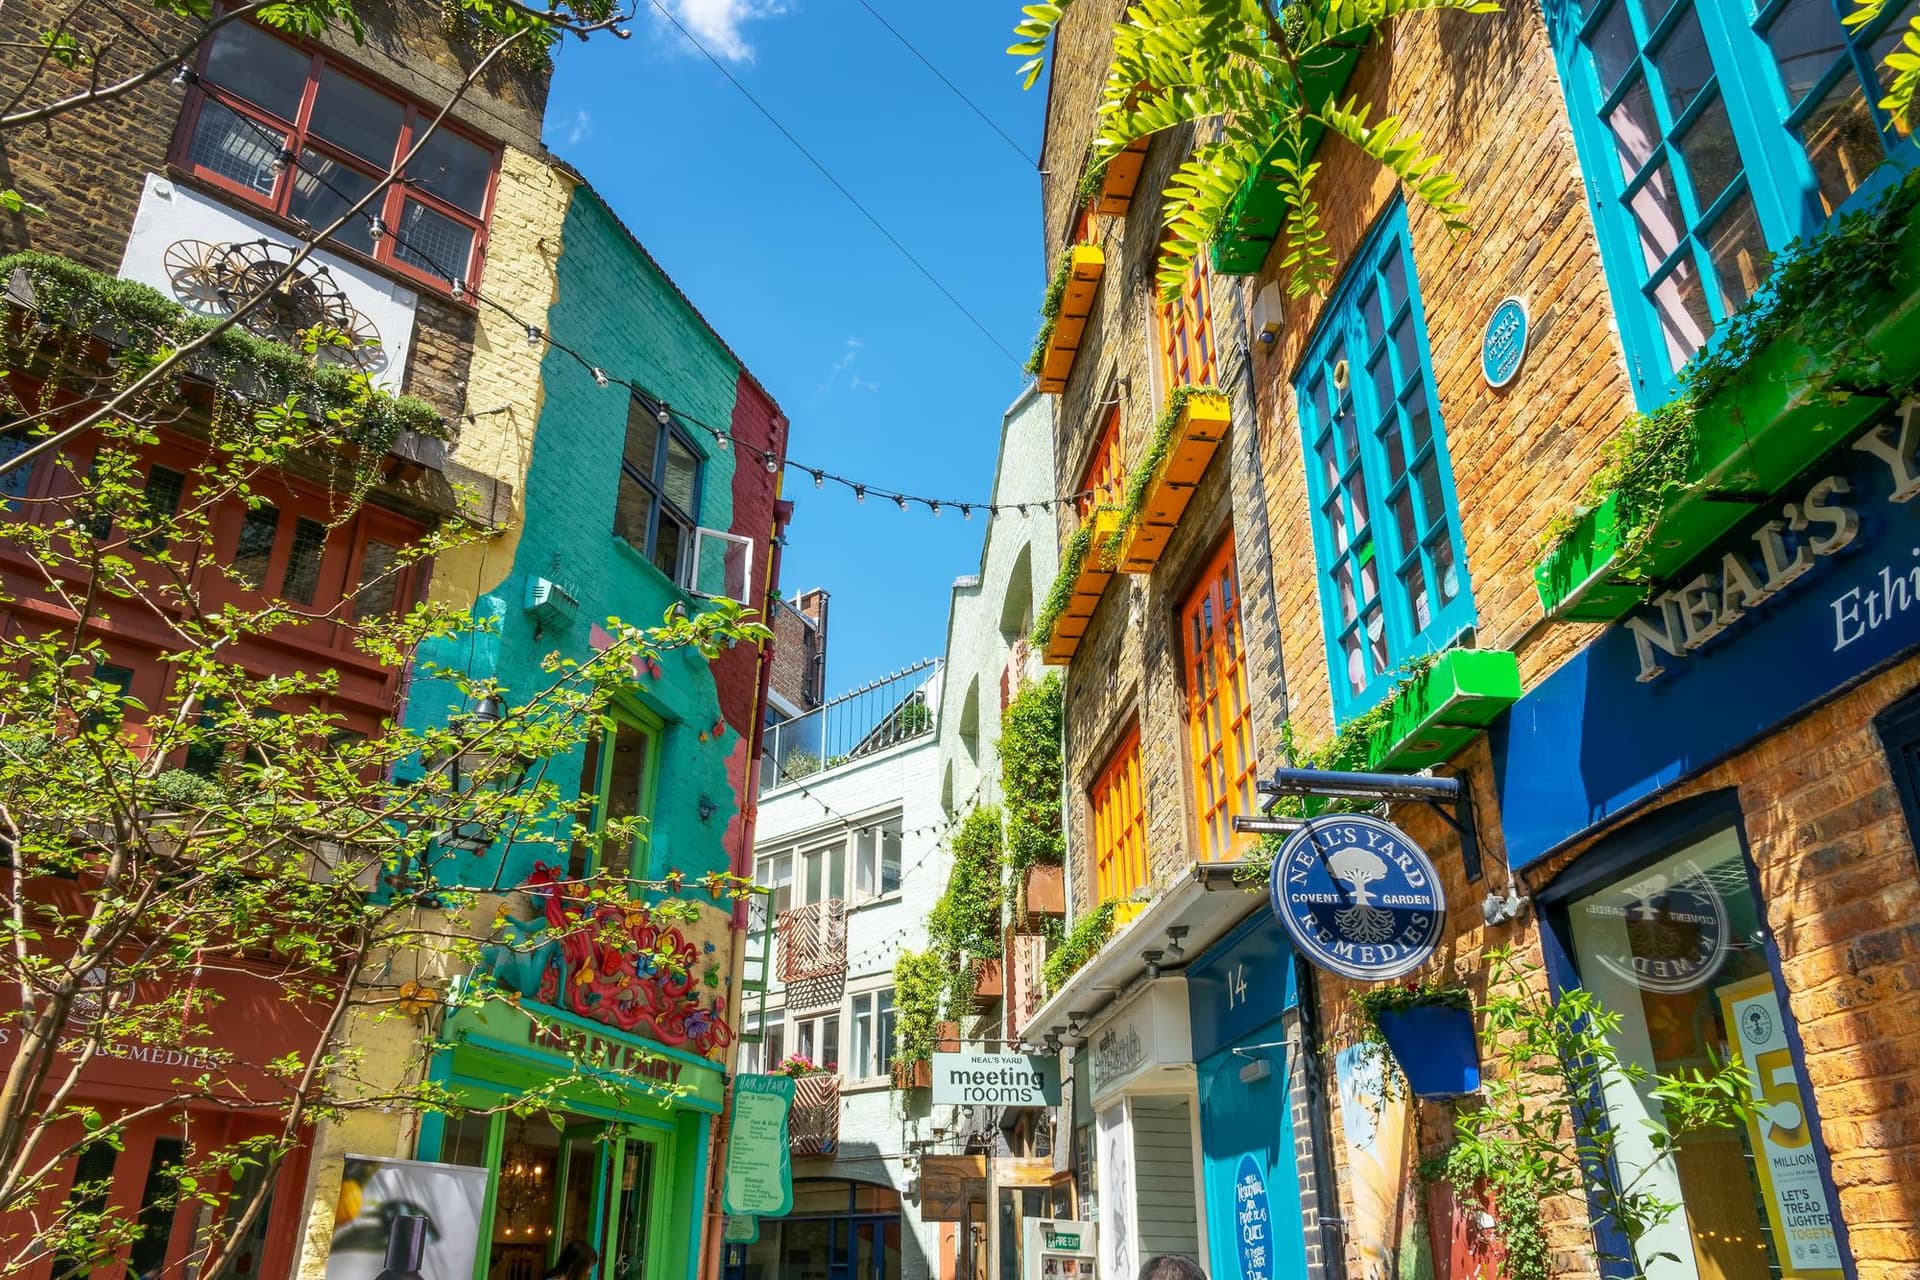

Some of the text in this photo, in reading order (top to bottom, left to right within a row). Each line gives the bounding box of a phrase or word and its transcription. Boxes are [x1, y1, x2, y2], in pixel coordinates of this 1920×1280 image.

[1624, 476, 1859, 682] NEAL'S
[1290, 828, 1426, 889] NEAL'S YARD
[1292, 893, 1430, 905] COVENT GARDEN
[1299, 912, 1430, 963] REMEDIES
[971, 1056, 1023, 1065] NEAL'S YARD
[739, 1077, 757, 1091] HAIR
[767, 1080, 790, 1094] FAIRY
[950, 1067, 1045, 1090] meeting
[964, 1086, 1033, 1102] rooms
[1755, 1048, 1813, 1149] 5
[1773, 1153, 1815, 1168] MILLION
[1781, 1189, 1810, 1202] LET'S
[1784, 1202, 1820, 1215] TREAD
[1056, 1236, 1079, 1247] FIRE EXIT
